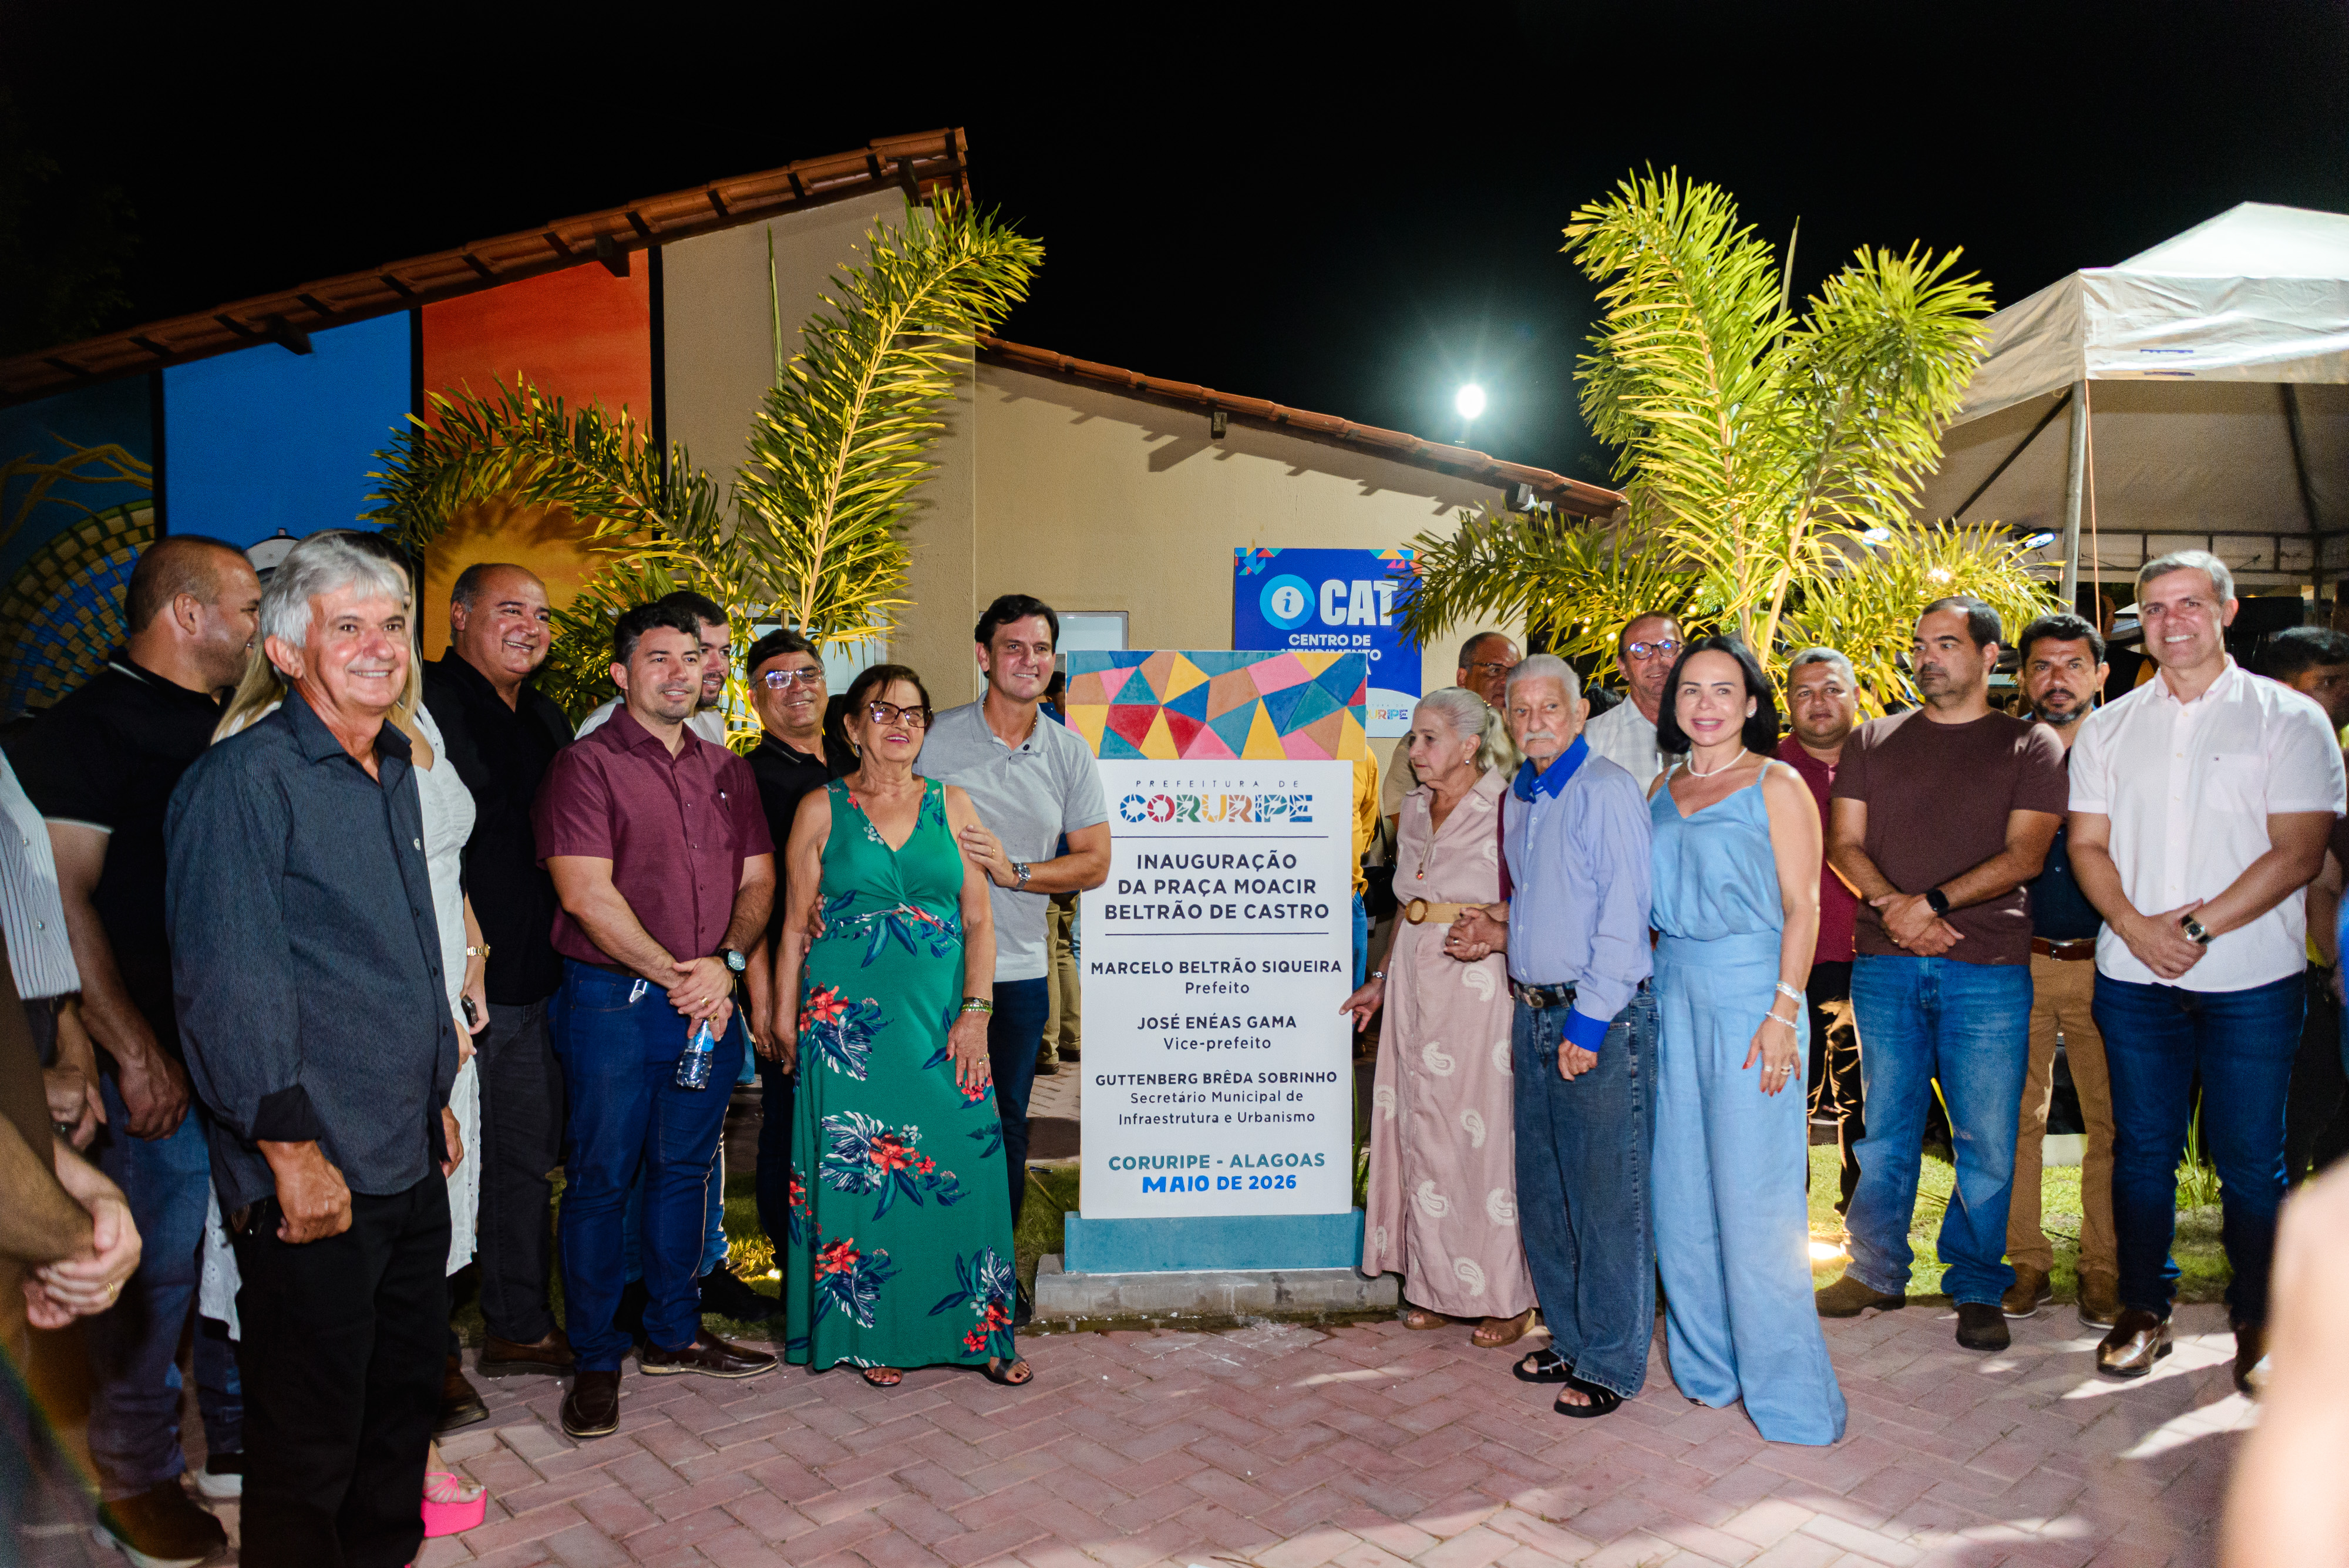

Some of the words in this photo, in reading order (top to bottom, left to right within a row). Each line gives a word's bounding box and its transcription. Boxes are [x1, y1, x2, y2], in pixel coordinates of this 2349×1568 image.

[1320, 578, 1399, 626] CAT
[1288, 634, 1349, 646] CENTRO
[1352, 634, 1371, 647] DE
[1119, 793, 1313, 823] CORURIPE
[1137, 849, 1297, 873] INAUGURAÇÃO
[1118, 879, 1147, 895] DA
[1154, 879, 1227, 897] PRAÇA
[1234, 879, 1316, 894] MOACIR
[1105, 900, 1203, 920] BELTRÃO
[1210, 904, 1237, 919] DE
[1244, 903, 1329, 919] CASTRO
[1091, 961, 1173, 975] MARCELO
[1179, 957, 1257, 974] BELTRÃO
[1262, 960, 1342, 973] SIQUEIRA
[1185, 981, 1250, 994] Prefeito
[1137, 1012, 1180, 1030] JOSÉ
[1186, 1012, 1241, 1029] ENÉAS
[1247, 1015, 1297, 1029] GAMA
[1163, 1036, 1271, 1052] Vice-prefeito
[1095, 1073, 1198, 1086] GUTTENBERG
[1203, 1069, 1253, 1084] BRÊDA
[1258, 1071, 1337, 1084] SOBRINHO
[1130, 1091, 1206, 1104] Secretário
[1211, 1089, 1281, 1104] Municipal
[1286, 1089, 1303, 1102] de
[1119, 1112, 1219, 1126] Infraestrutura
[1224, 1114, 1232, 1123] e
[1237, 1111, 1315, 1123] Urbanismo
[1108, 1154, 1210, 1171] CORURIPE
[1229, 1152, 1325, 1168] ALAGOAS
[1142, 1175, 1210, 1193] MAIO
[1217, 1175, 1243, 1190] DE
[1248, 1174, 1297, 1190] 2026
